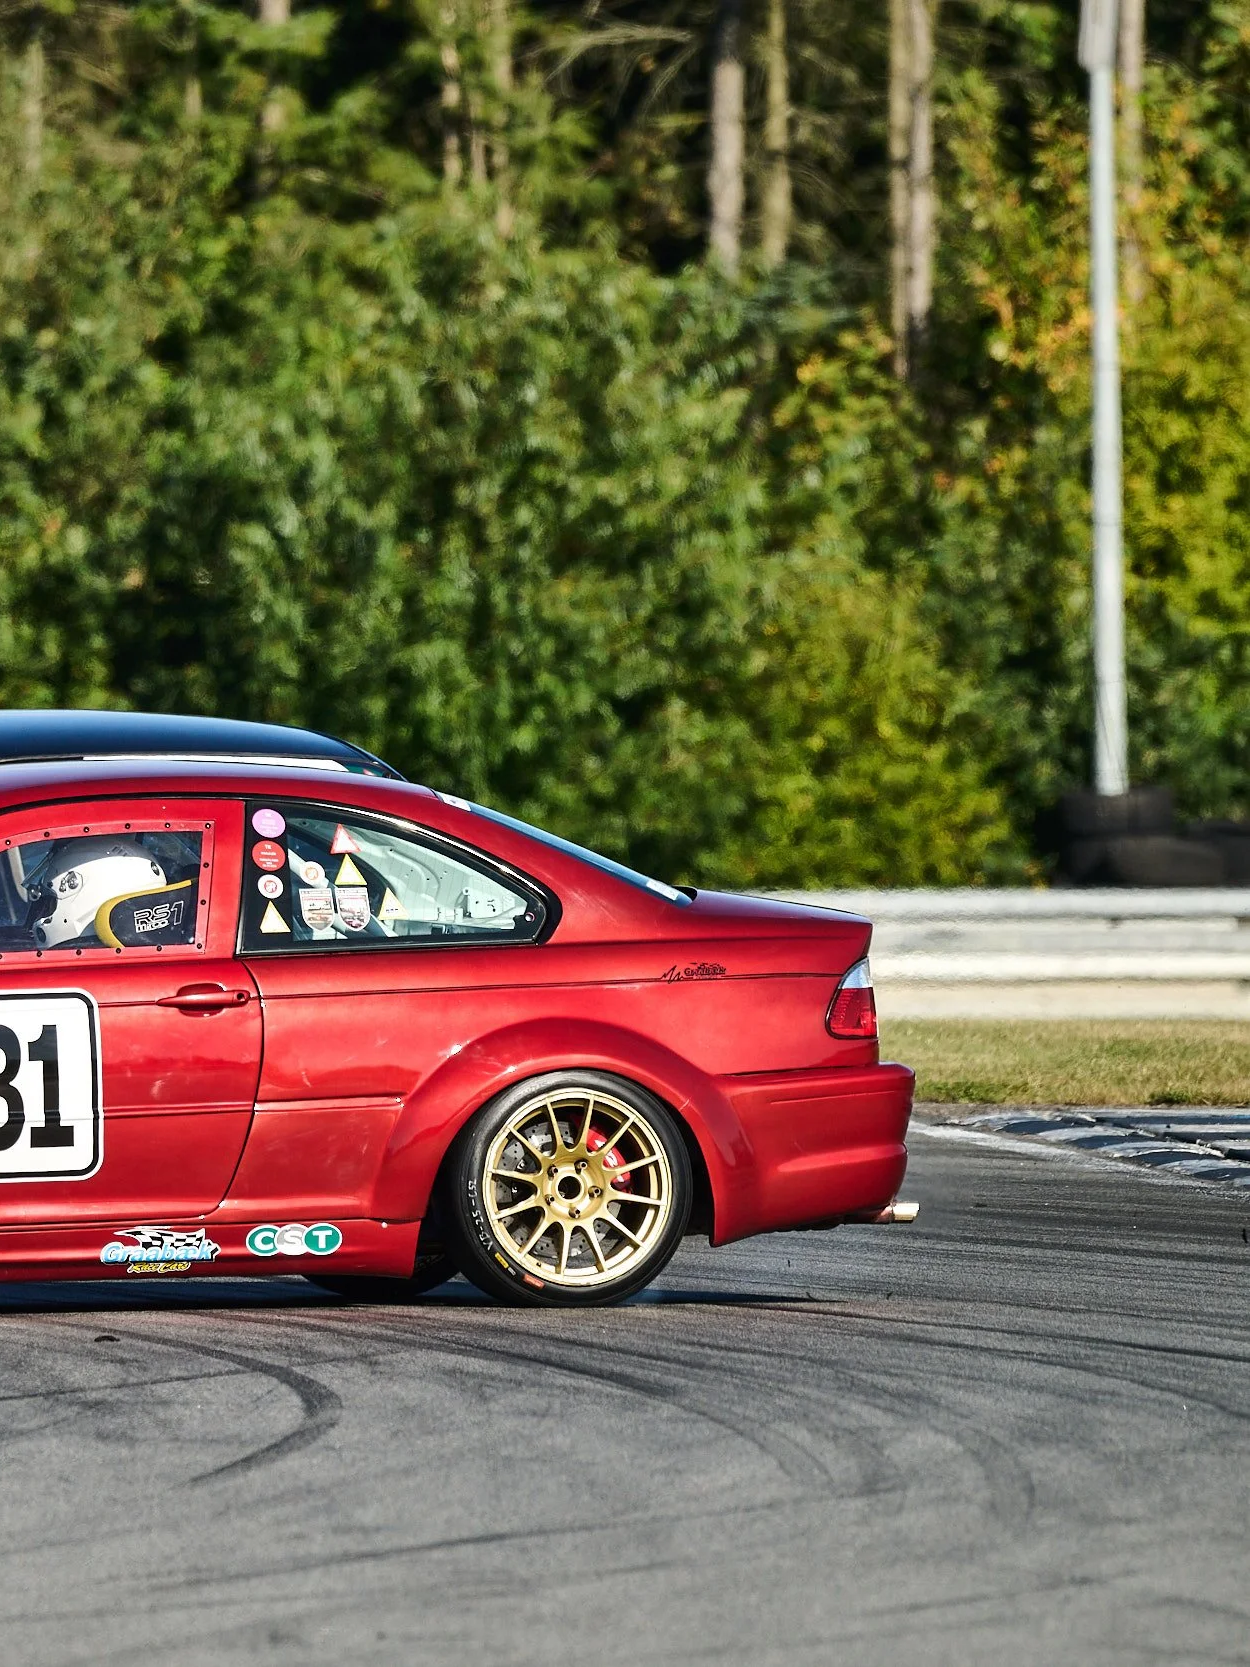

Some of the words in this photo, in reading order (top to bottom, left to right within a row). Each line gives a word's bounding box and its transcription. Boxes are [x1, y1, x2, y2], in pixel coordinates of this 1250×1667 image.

[134, 900, 184, 925] RS1
[251, 1227, 337, 1252] CST
[101, 1240, 218, 1264] Graabæk
[127, 1262, 160, 1273] Race
[158, 1261, 191, 1273] Cars
